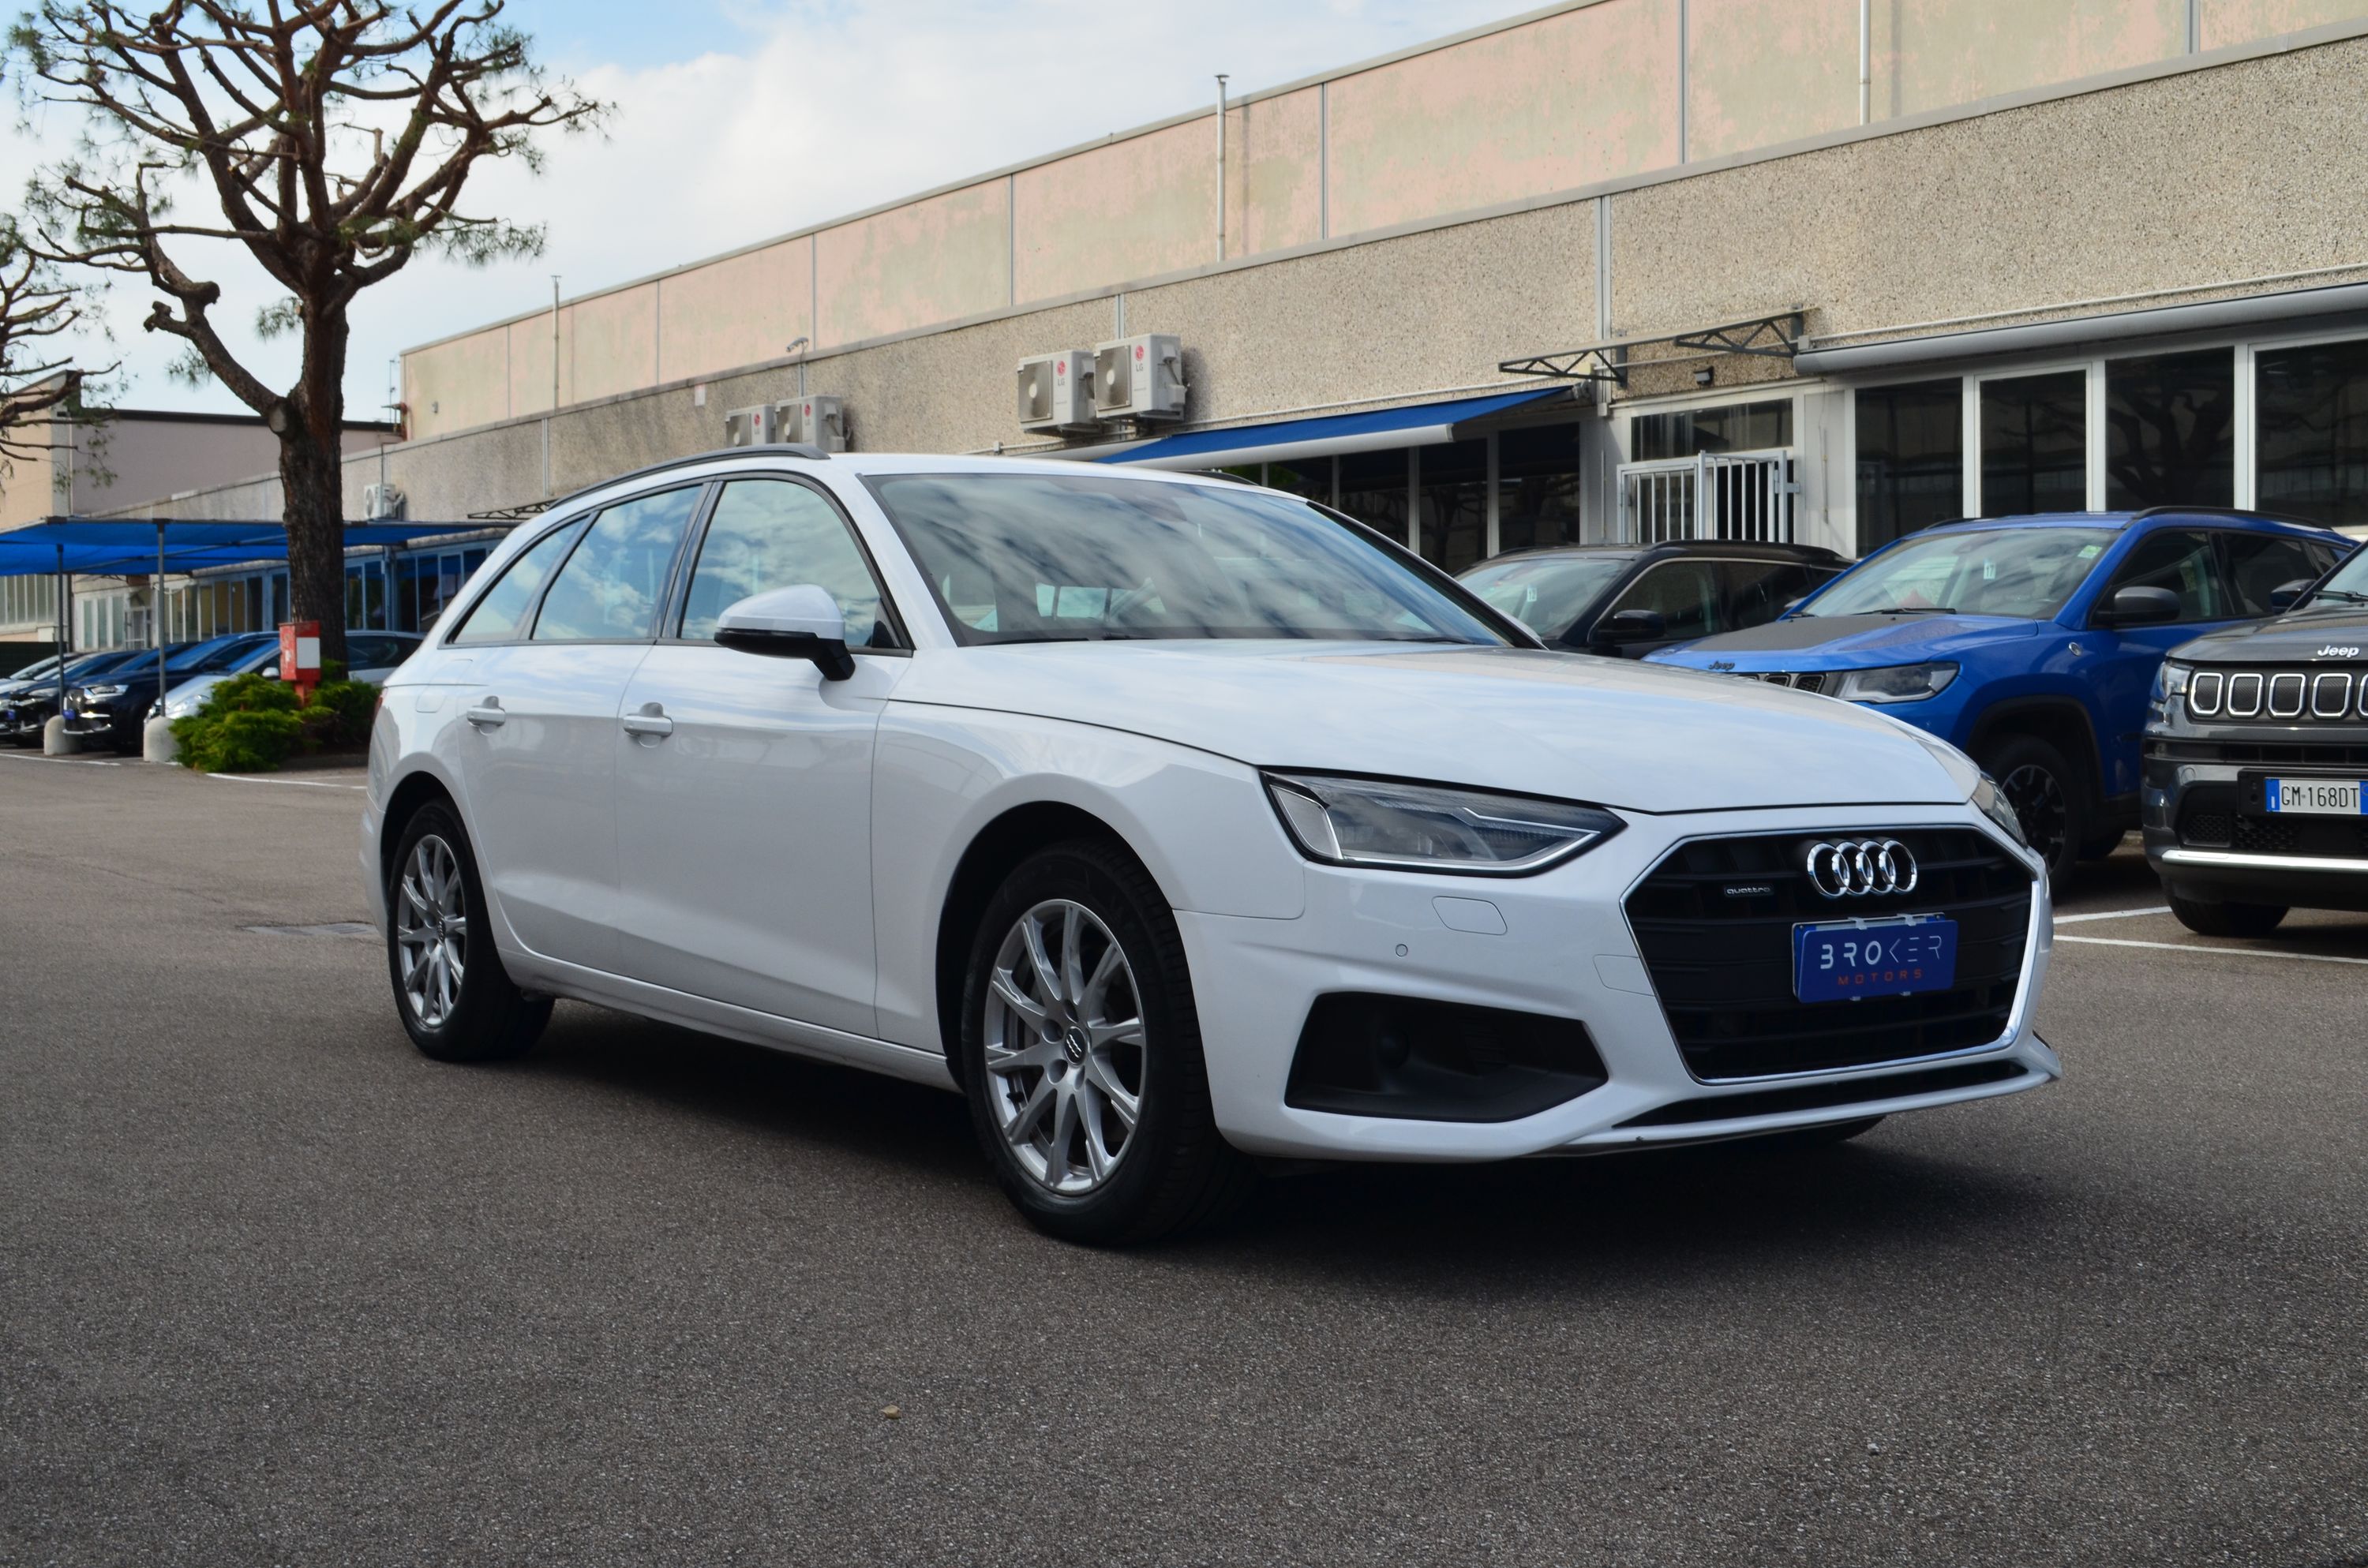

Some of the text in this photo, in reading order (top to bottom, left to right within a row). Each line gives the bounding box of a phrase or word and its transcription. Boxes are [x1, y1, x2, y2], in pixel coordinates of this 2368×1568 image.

[2317, 645, 2359, 658] Jeep
[1820, 935, 1943, 970] BROKER
[1838, 968, 1924, 986] MOTORS
